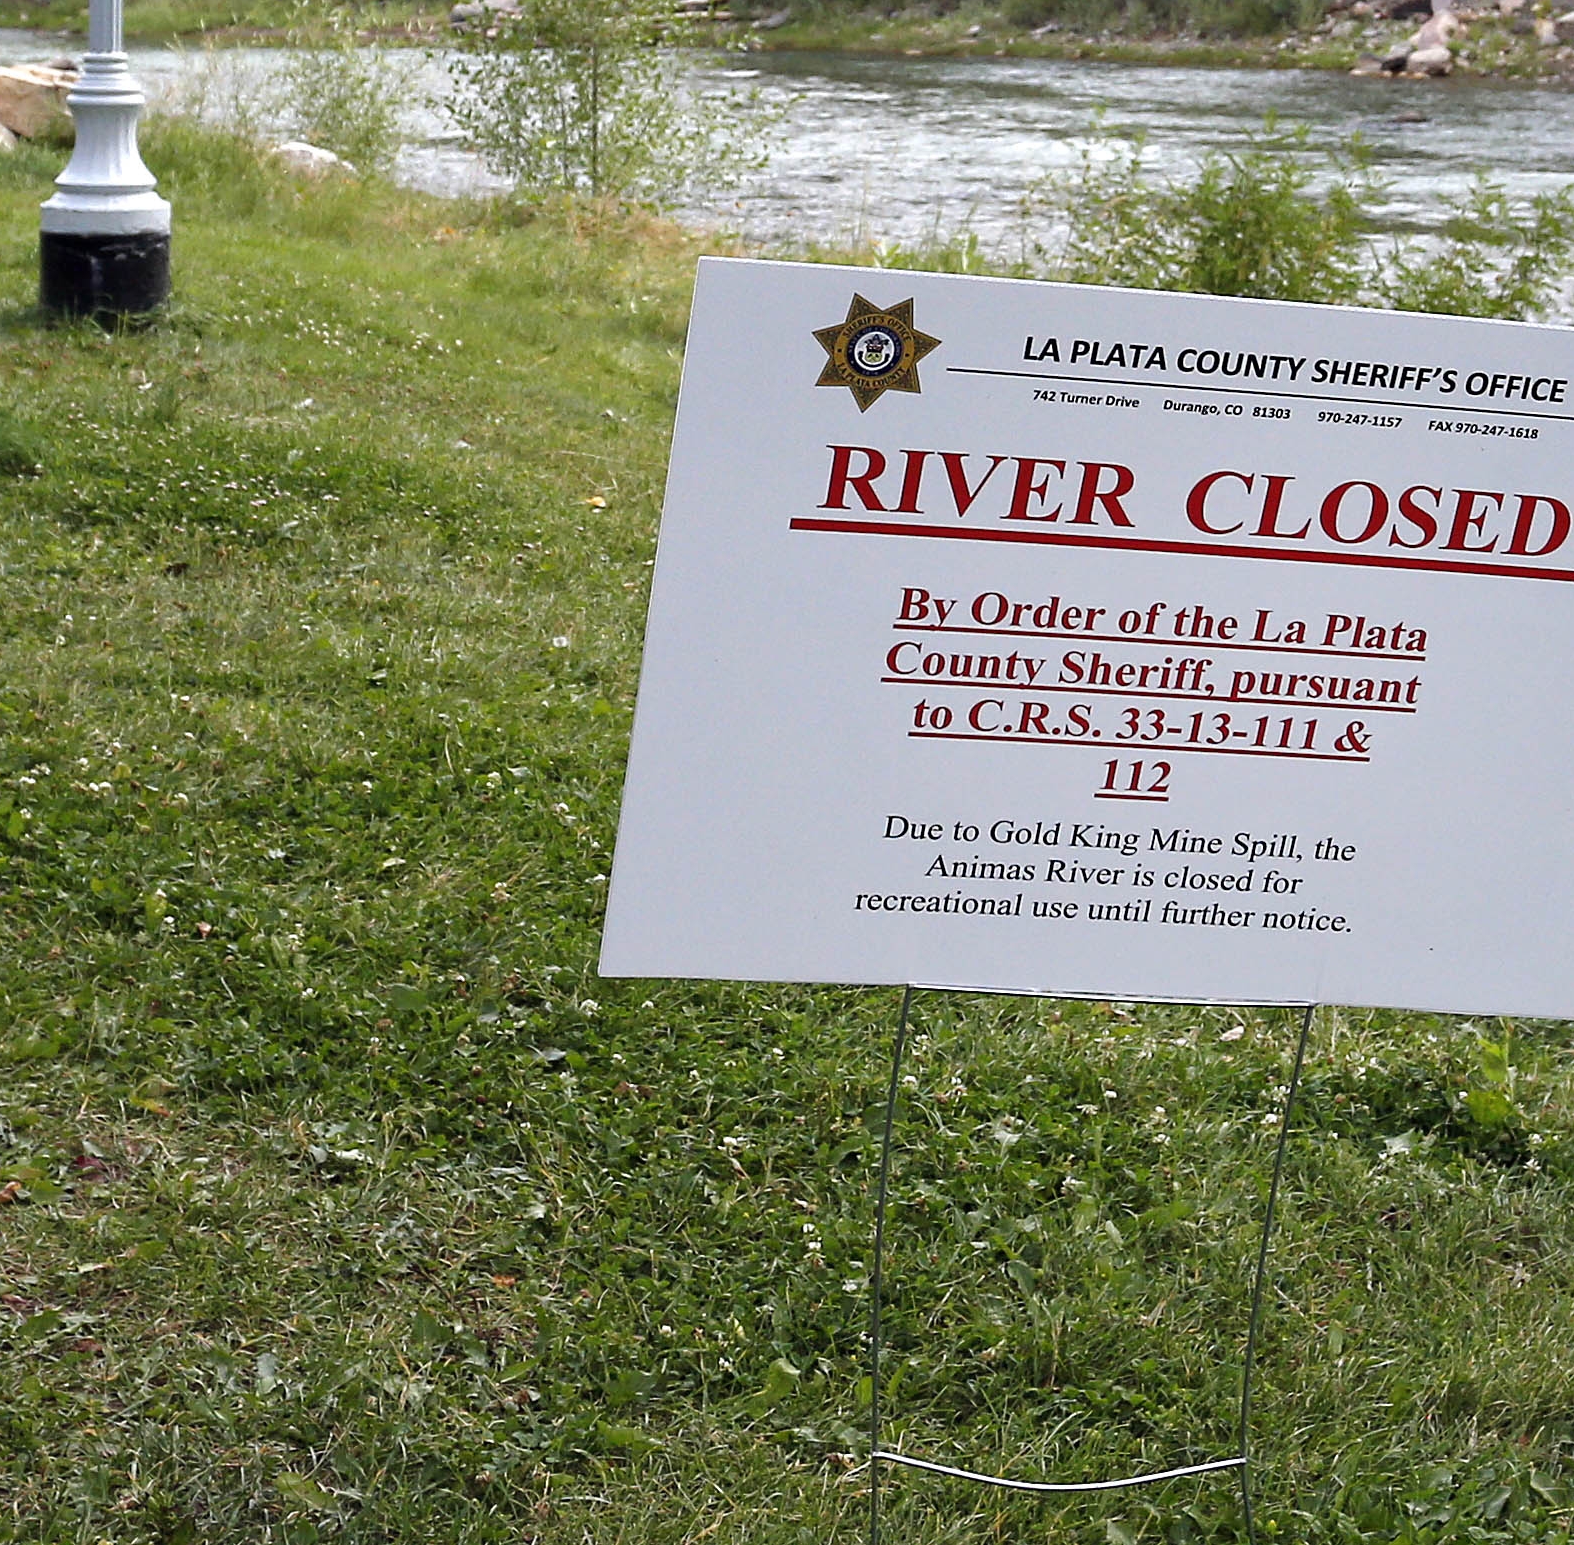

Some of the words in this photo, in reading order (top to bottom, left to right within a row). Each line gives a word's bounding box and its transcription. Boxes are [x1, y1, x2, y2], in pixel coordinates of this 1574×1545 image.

[1024, 337, 1060, 362] LA
[1070, 340, 1166, 370] PLATA
[1177, 349, 1306, 380] COUNTY
[1311, 360, 1457, 393] SHERIFF'S
[1466, 373, 1568, 402] OFFICE
[1033, 389, 1057, 402] 742
[1059, 391, 1104, 406] Turner
[1105, 395, 1140, 408] Drive
[1163, 399, 1221, 416] Durango,
[1224, 404, 1244, 416] CO
[1252, 406, 1291, 420] 81303
[1317, 411, 1403, 428] 970-247-1157
[1427, 420, 1454, 433] FAX
[1454, 422, 1539, 440] 970-247-1618
[816, 445, 1135, 527] RIVER
[1186, 471, 1571, 556] CLOSED
[896, 588, 958, 628] By
[972, 592, 1106, 631] Order
[1119, 603, 1166, 634] of
[1174, 606, 1237, 639] the
[1250, 610, 1305, 644] La
[1320, 614, 1426, 652] Plata
[886, 642, 1047, 689] County
[1058, 651, 1215, 698] Sheriff,
[1229, 669, 1422, 704] pursuant
[914, 699, 952, 729] to
[969, 700, 1100, 737] C.R.S.
[1115, 708, 1317, 750] 33-13-111
[1334, 721, 1372, 753] &
[1097, 759, 1172, 793] 112
[883, 816, 943, 840] Due
[953, 821, 980, 843] to
[990, 821, 1060, 845] Gold
[1068, 824, 1140, 856] King
[1148, 828, 1222, 854] Mine
[1231, 833, 1302, 863] Spill,
[1315, 837, 1355, 861] the
[925, 855, 1035, 881] Animas
[1044, 860, 1125, 885] River
[1132, 863, 1154, 887] is
[1165, 866, 1254, 891] closed
[1261, 871, 1303, 894] for
[854, 891, 1022, 916] recreational
[1032, 901, 1079, 919] use
[1089, 899, 1151, 922] until
[1161, 901, 1255, 927] further
[1262, 908, 1351, 932] notice.
